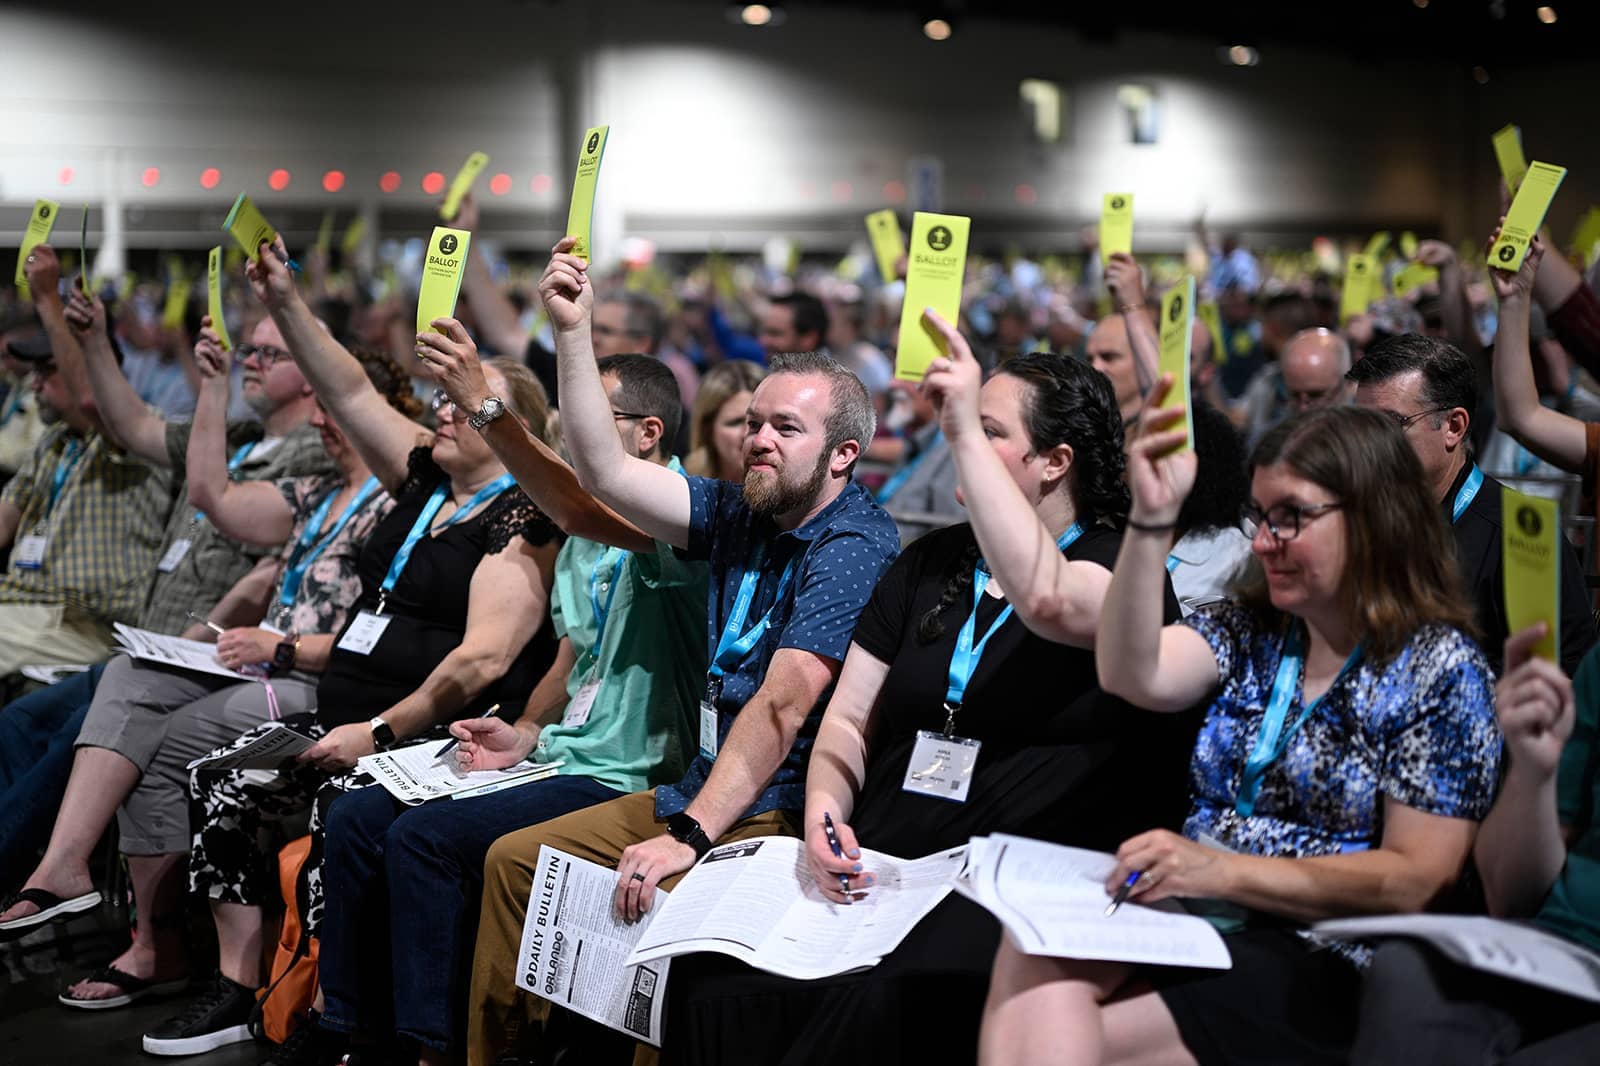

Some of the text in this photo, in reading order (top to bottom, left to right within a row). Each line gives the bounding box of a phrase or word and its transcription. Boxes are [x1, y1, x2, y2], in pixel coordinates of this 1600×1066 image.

[428, 255, 459, 267] BALLOT
[372, 757, 411, 790] BULLETIN
[528, 930, 544, 973] DAILY
[537, 856, 561, 927] BULLETIN
[545, 931, 564, 995] ORLANDO
